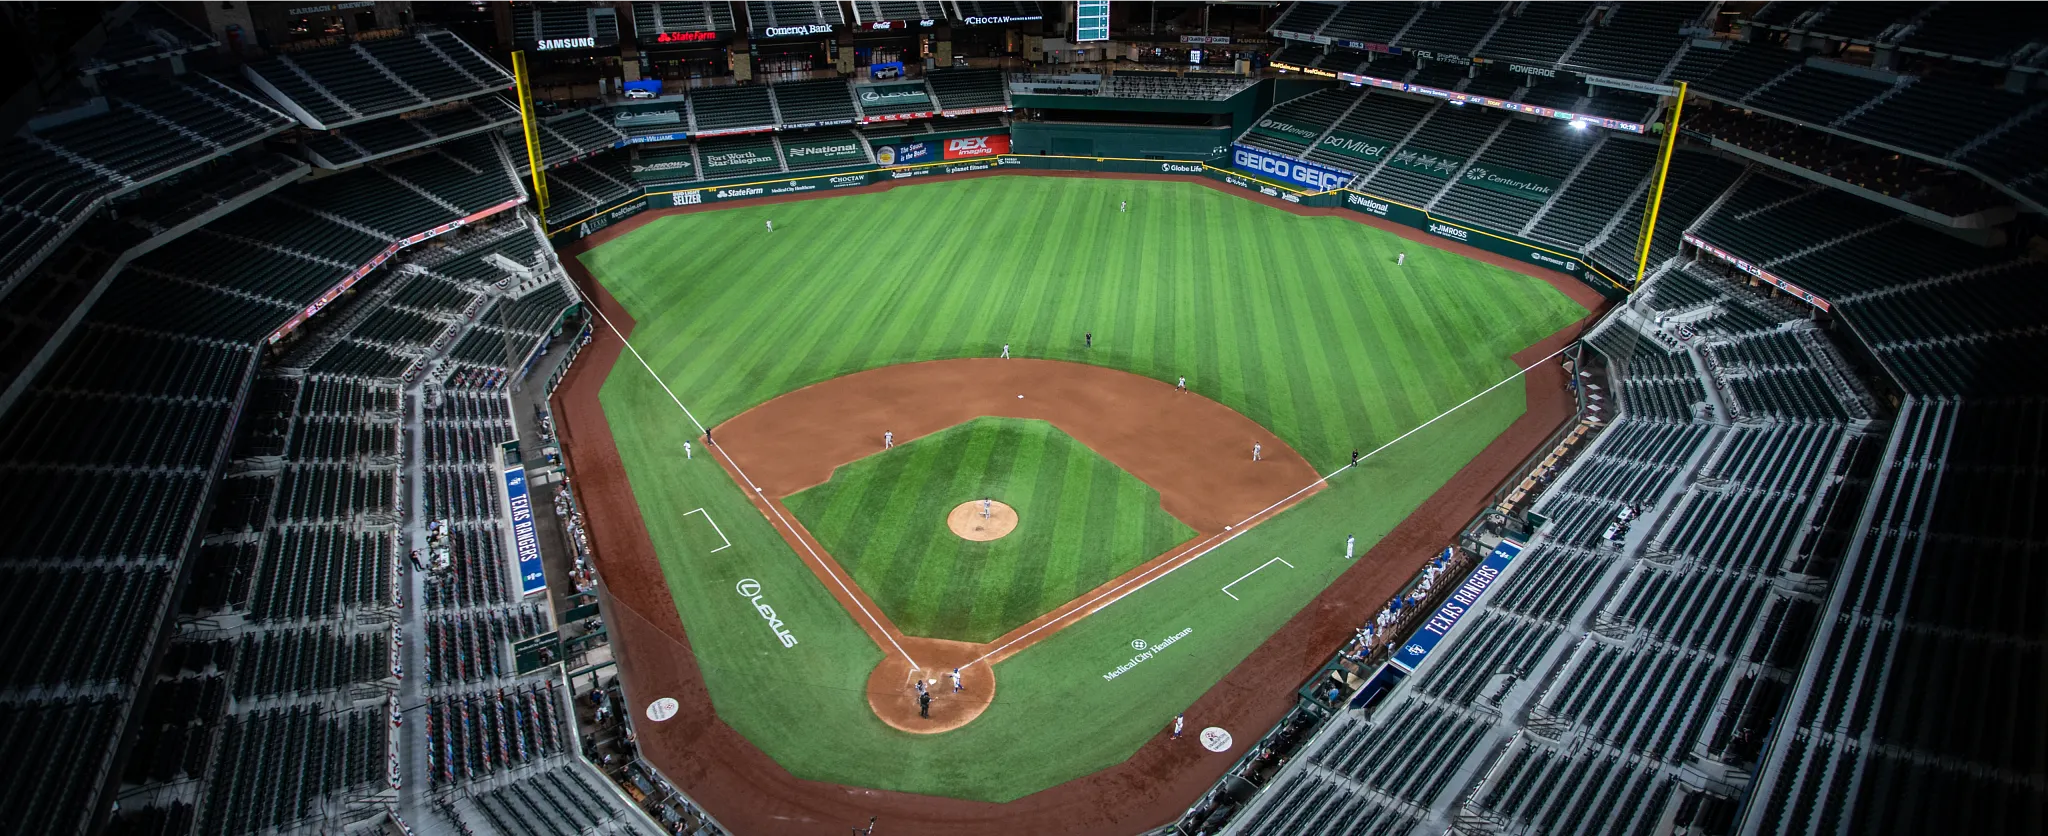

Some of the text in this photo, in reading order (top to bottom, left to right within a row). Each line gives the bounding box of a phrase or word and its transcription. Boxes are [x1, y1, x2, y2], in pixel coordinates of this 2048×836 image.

[289, 0, 375, 15] KARBACH BREWING
[970, 16, 1010, 24] CHOCTAW
[809, 23, 833, 34] Bank
[538, 38, 595, 50] SAMSUNG
[1417, 50, 1434, 59] PGL
[1509, 64, 1556, 77] POWERADE
[880, 90, 924, 98] LEXUS
[1270, 121, 1318, 139] TXUenergy
[805, 143, 857, 155] National
[949, 136, 988, 151] DEX
[1342, 139, 1385, 157] Mitel
[900, 146, 909, 154] The
[958, 147, 992, 156] imaging
[707, 151, 756, 163] Fort Worth
[951, 165, 969, 174] planet
[1171, 164, 1190, 172] Globe
[1235, 150, 1289, 177] GEICO
[832, 174, 865, 183] CHOCTAW
[1487, 174, 1551, 194] CenturyLink
[772, 186, 787, 194] Medical
[786, 185, 795, 194] City
[673, 194, 701, 206] SELTZER
[1357, 195, 1389, 212] National
[611, 200, 647, 219] RoofClaim.com
[590, 217, 608, 228] TEXAS
[511, 494, 538, 562] TEXAS RANGERS
[1425, 565, 1498, 635] TEXAS RANGERS
[751, 595, 798, 648] LEXUS
[1102, 627, 1193, 681] Medical City Healthcare
